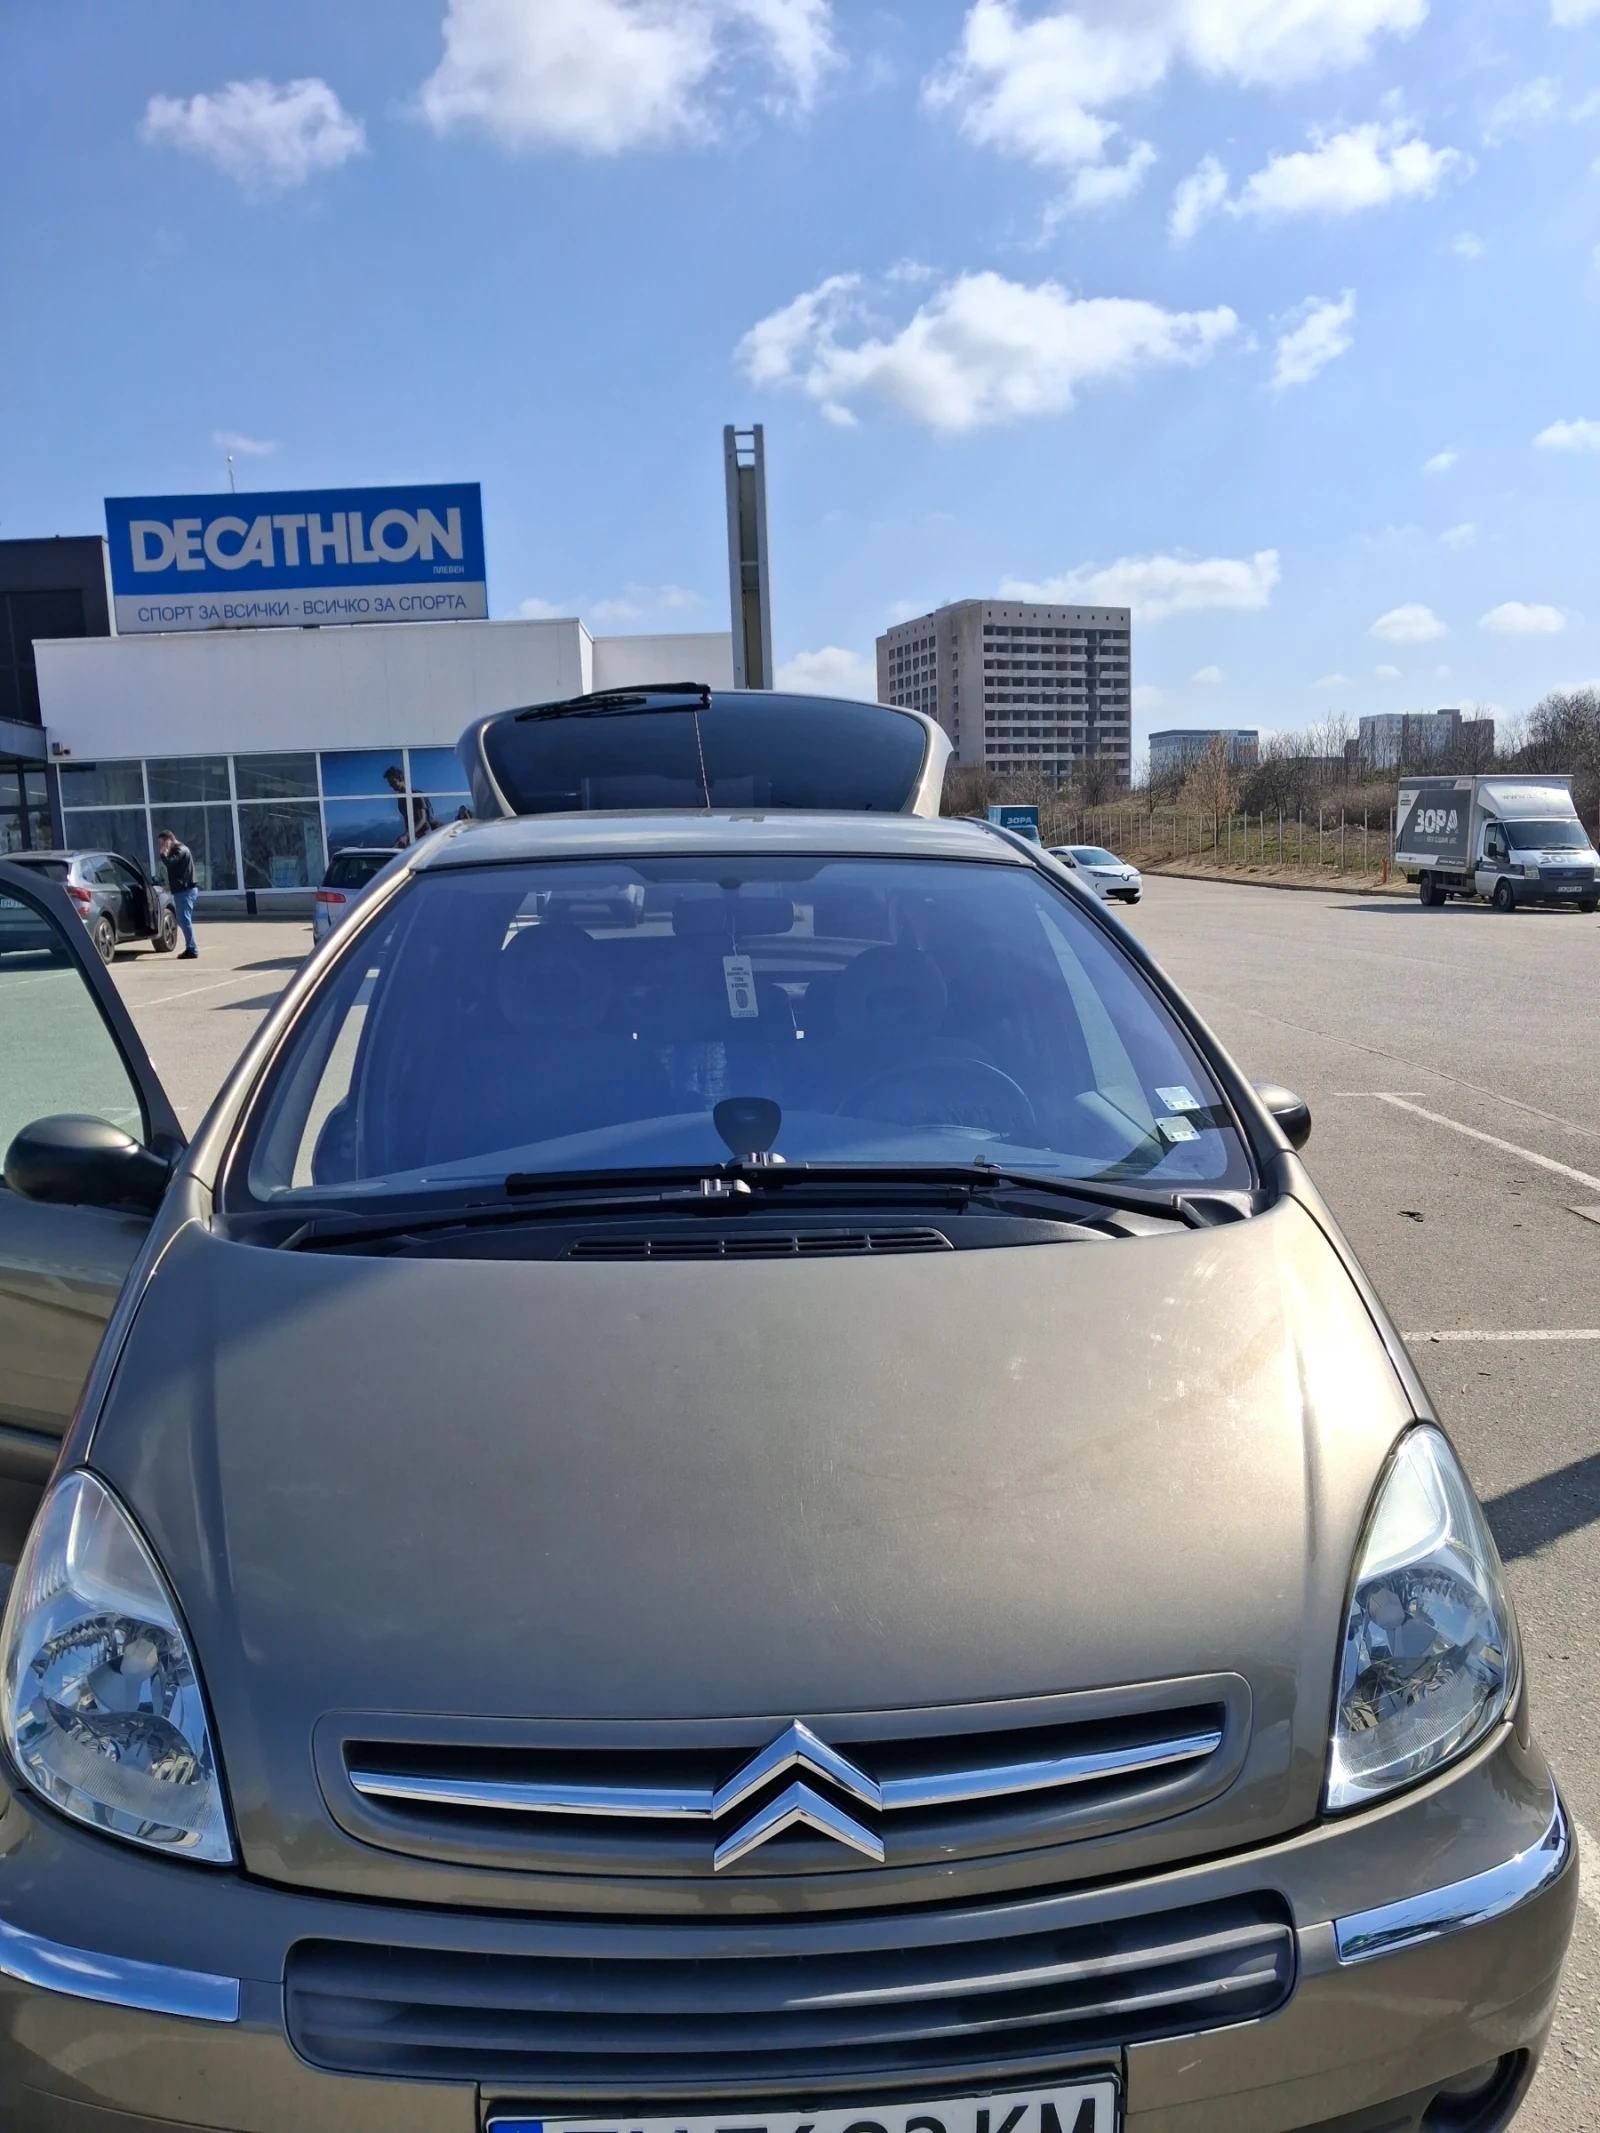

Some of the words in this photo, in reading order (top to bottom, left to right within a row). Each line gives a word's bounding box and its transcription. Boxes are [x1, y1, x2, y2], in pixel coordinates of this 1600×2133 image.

[129, 507, 465, 573] DECATHLON
[432, 565, 465, 575] ПЛЕВЕН
[138, 606, 195, 623] СПОРТ
[198, 605, 221, 620] ЗА
[224, 601, 290, 619] ВСИЧКИ
[303, 597, 370, 616] ВСИЧКО
[373, 596, 396, 613] ЗА
[399, 594, 467, 611] СПОРТА
[1006, 816, 1032, 825] ЗОРА
[1414, 808, 1459, 834] ЗОРА
